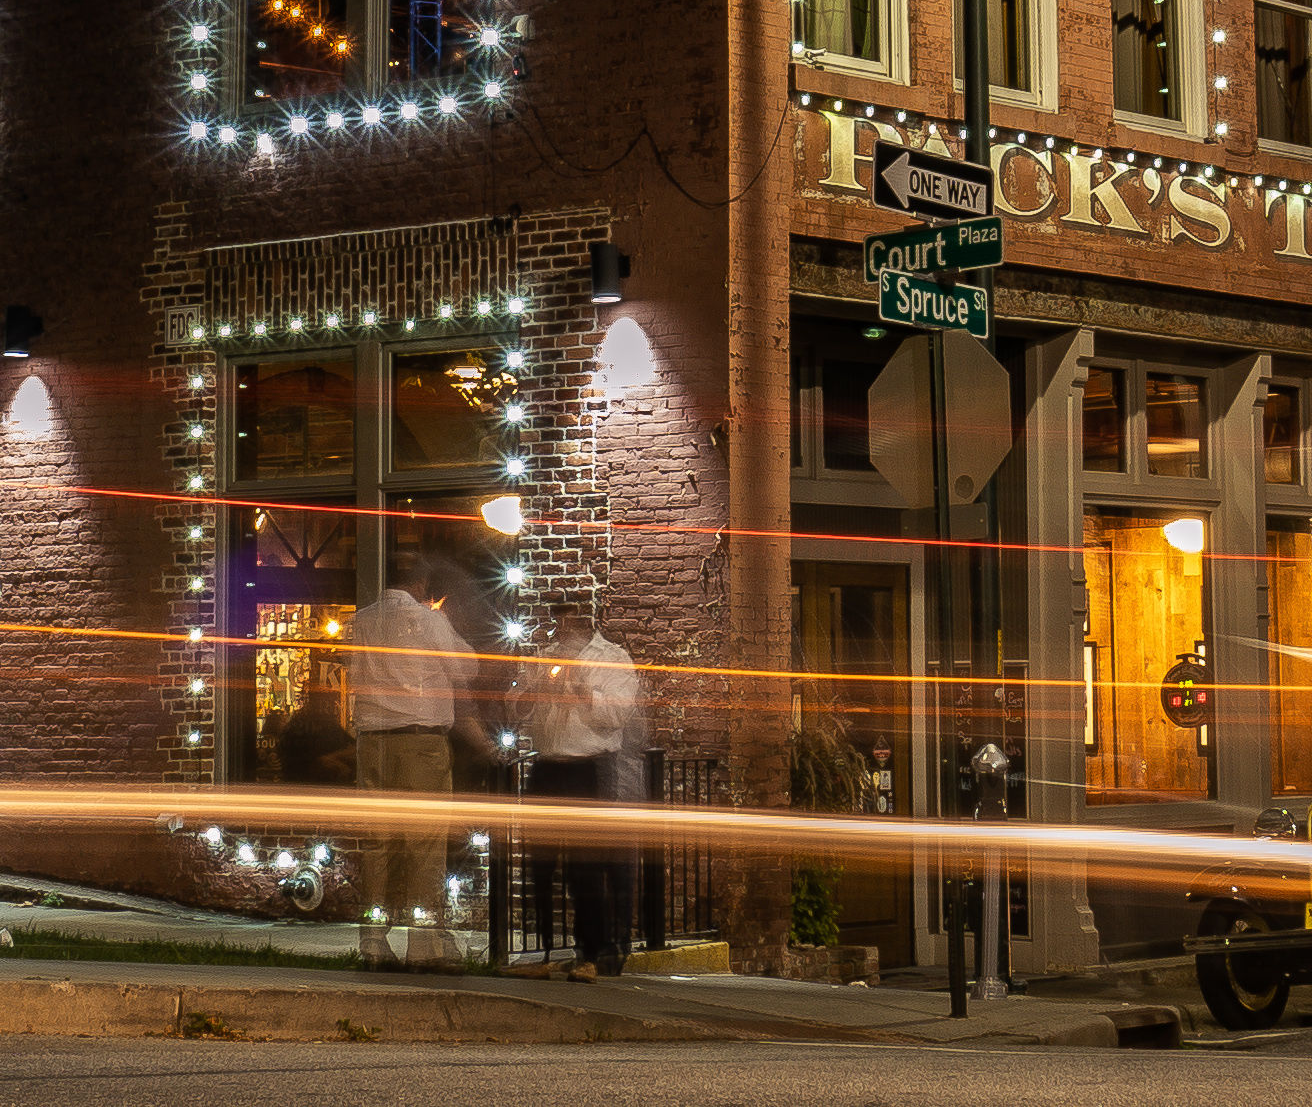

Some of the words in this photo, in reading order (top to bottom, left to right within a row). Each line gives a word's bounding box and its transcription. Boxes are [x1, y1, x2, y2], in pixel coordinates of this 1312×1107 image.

[909, 169, 942, 201] ONE
[946, 178, 981, 209] WAY
[868, 231, 947, 277] Court
[958, 226, 999, 246] Plaza
[882, 271, 890, 293] S
[896, 276, 969, 325] Spruce
[973, 291, 986, 311] St
